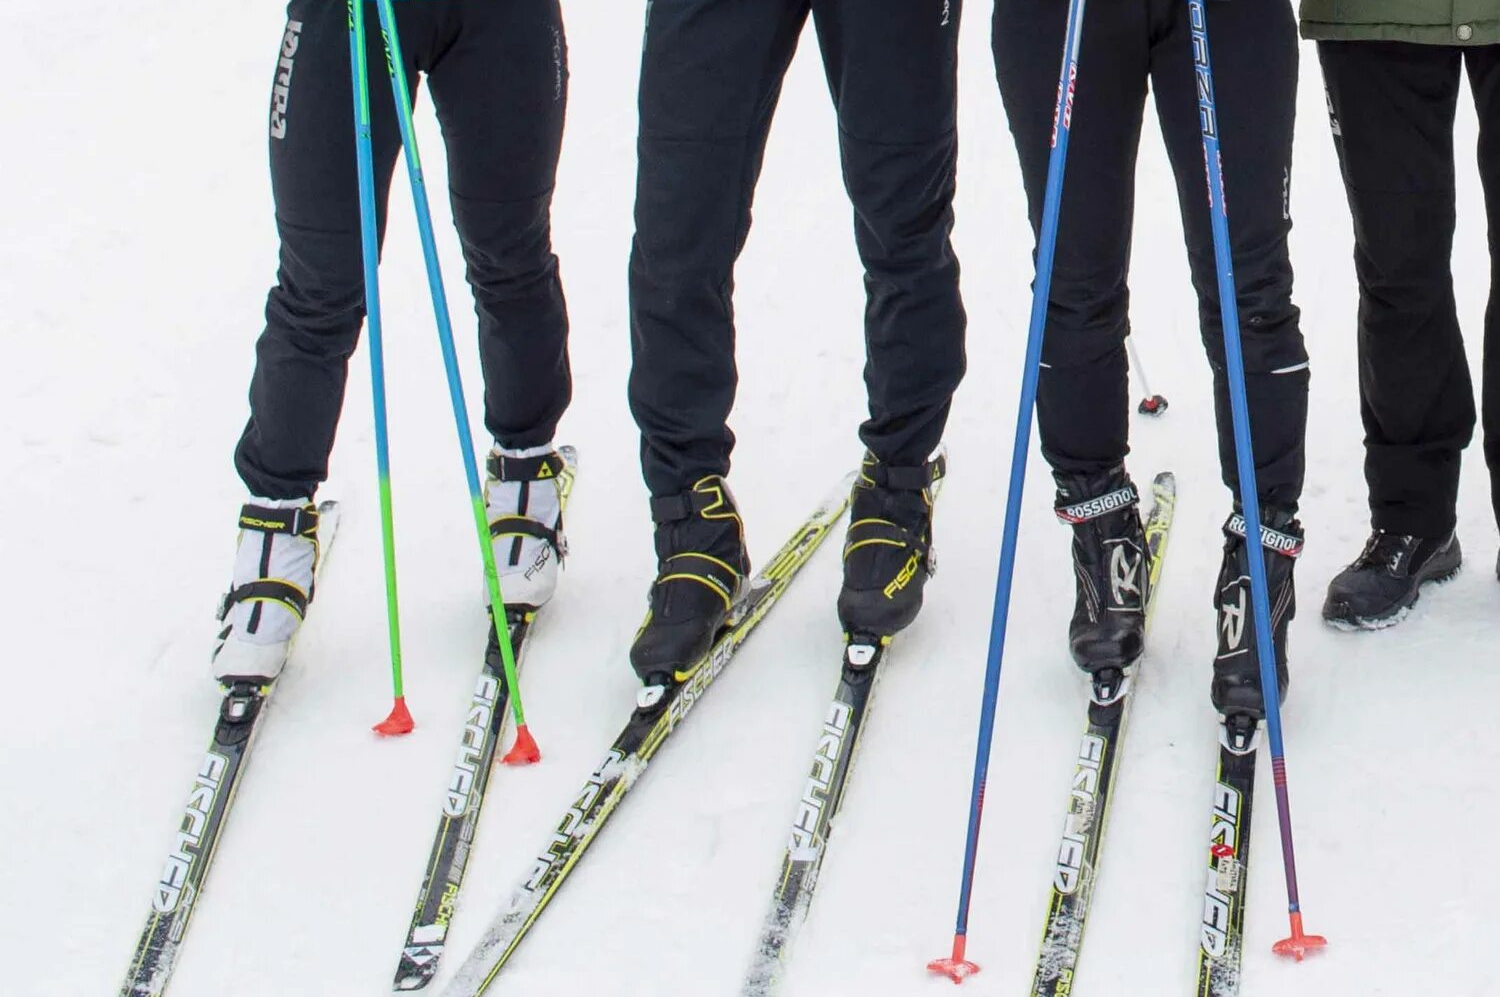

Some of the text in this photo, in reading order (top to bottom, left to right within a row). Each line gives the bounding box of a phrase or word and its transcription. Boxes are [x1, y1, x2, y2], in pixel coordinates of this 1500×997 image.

[1067, 487, 1138, 518] ROSSIGNOL
[444, 676, 496, 815] FISCHER
[666, 638, 734, 732] FISCHER
[154, 753, 224, 911] FISCHER
[1201, 782, 1240, 957] FISHER
